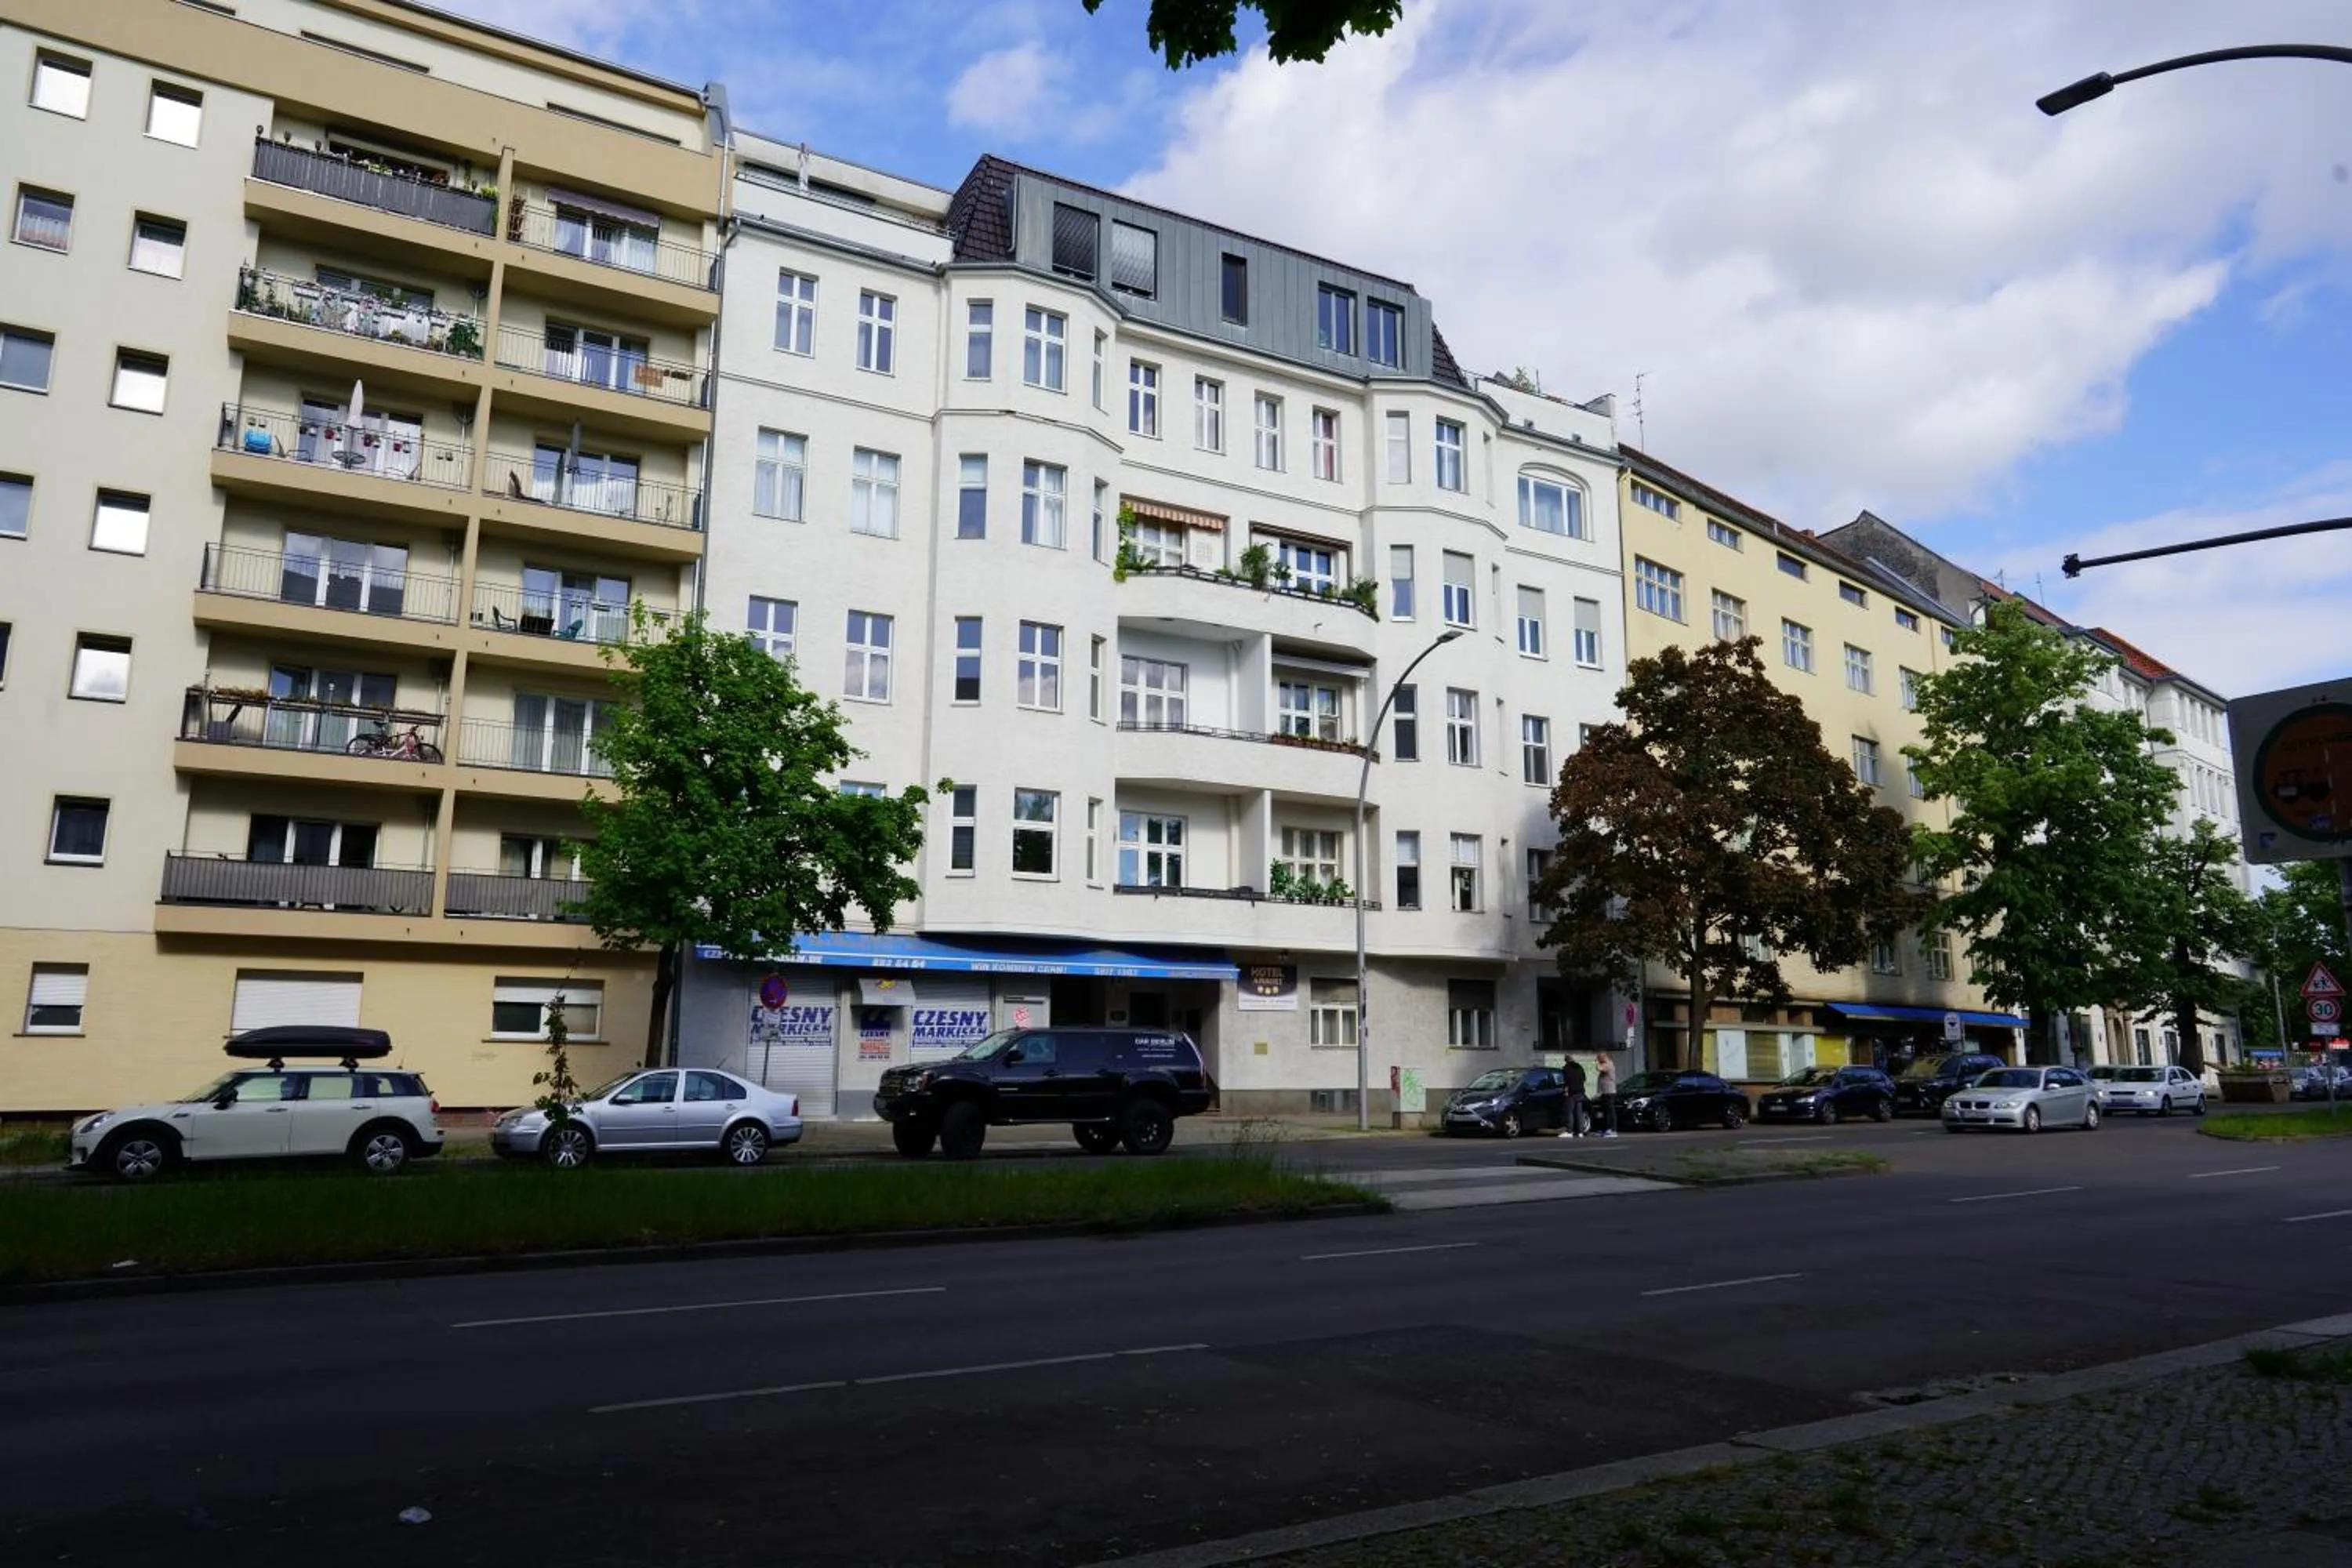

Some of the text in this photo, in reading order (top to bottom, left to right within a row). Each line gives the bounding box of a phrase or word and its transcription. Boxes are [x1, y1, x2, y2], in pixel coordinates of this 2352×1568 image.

[1250, 966, 1284, 978] HOTEL
[751, 1006, 833, 1022] CESNY
[2314, 1004, 2333, 1015] 30
[913, 1010, 988, 1026] CZESNY
[913, 1026, 987, 1038] MARKISEN
